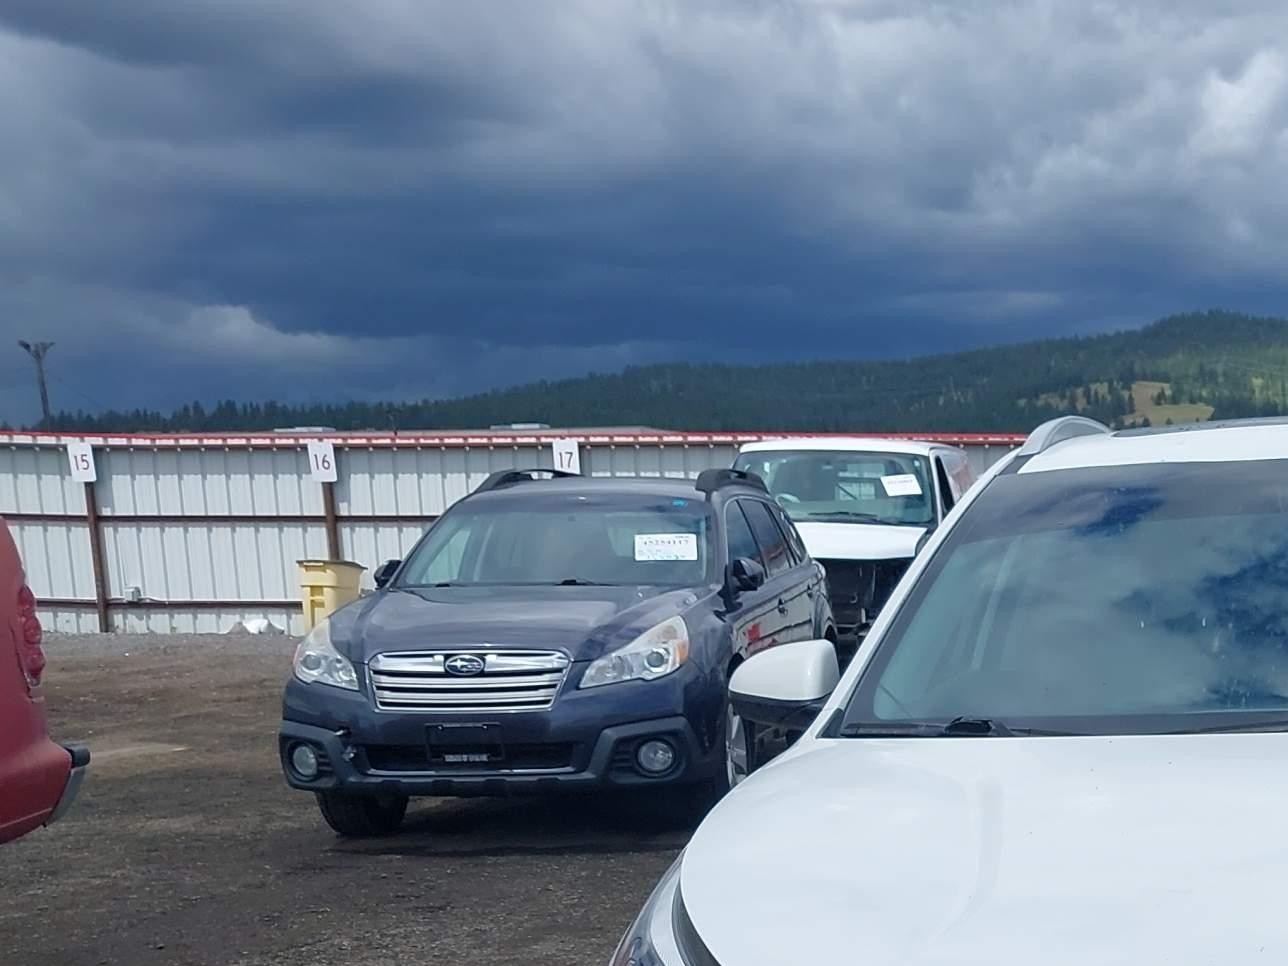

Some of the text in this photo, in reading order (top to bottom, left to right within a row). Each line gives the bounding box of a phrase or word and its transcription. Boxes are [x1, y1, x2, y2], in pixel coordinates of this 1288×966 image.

[73, 453, 90, 471] 15
[313, 453, 331, 471] 16
[558, 451, 574, 469] 17
